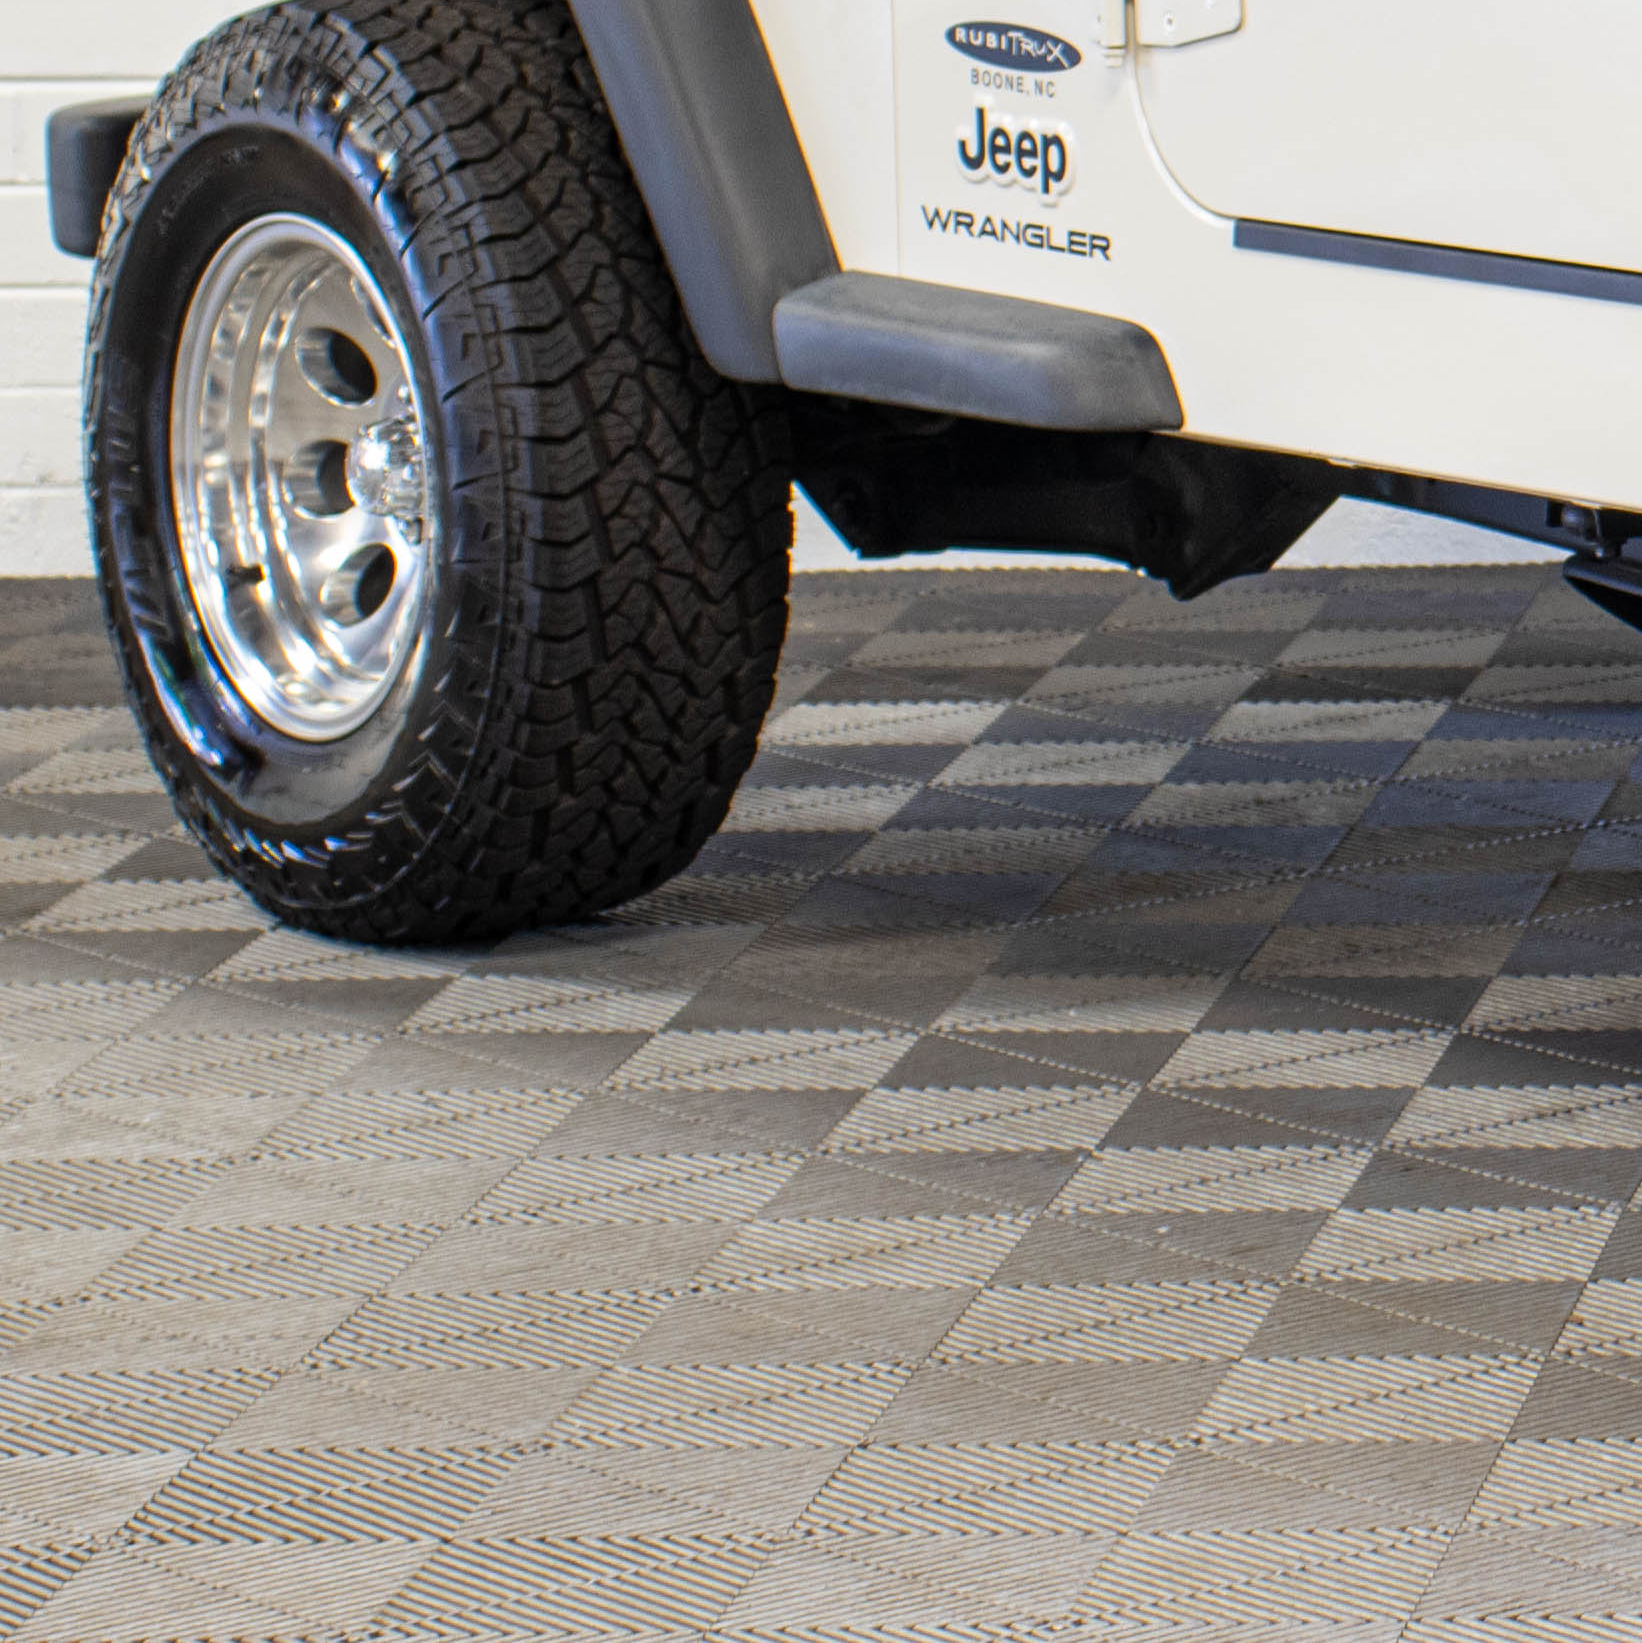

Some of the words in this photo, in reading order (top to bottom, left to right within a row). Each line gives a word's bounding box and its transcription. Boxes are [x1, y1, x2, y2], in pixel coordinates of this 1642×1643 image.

[1034, 77, 1056, 98] NC
[957, 106, 1067, 195] Jeep
[920, 204, 1111, 261] WRANGLER
